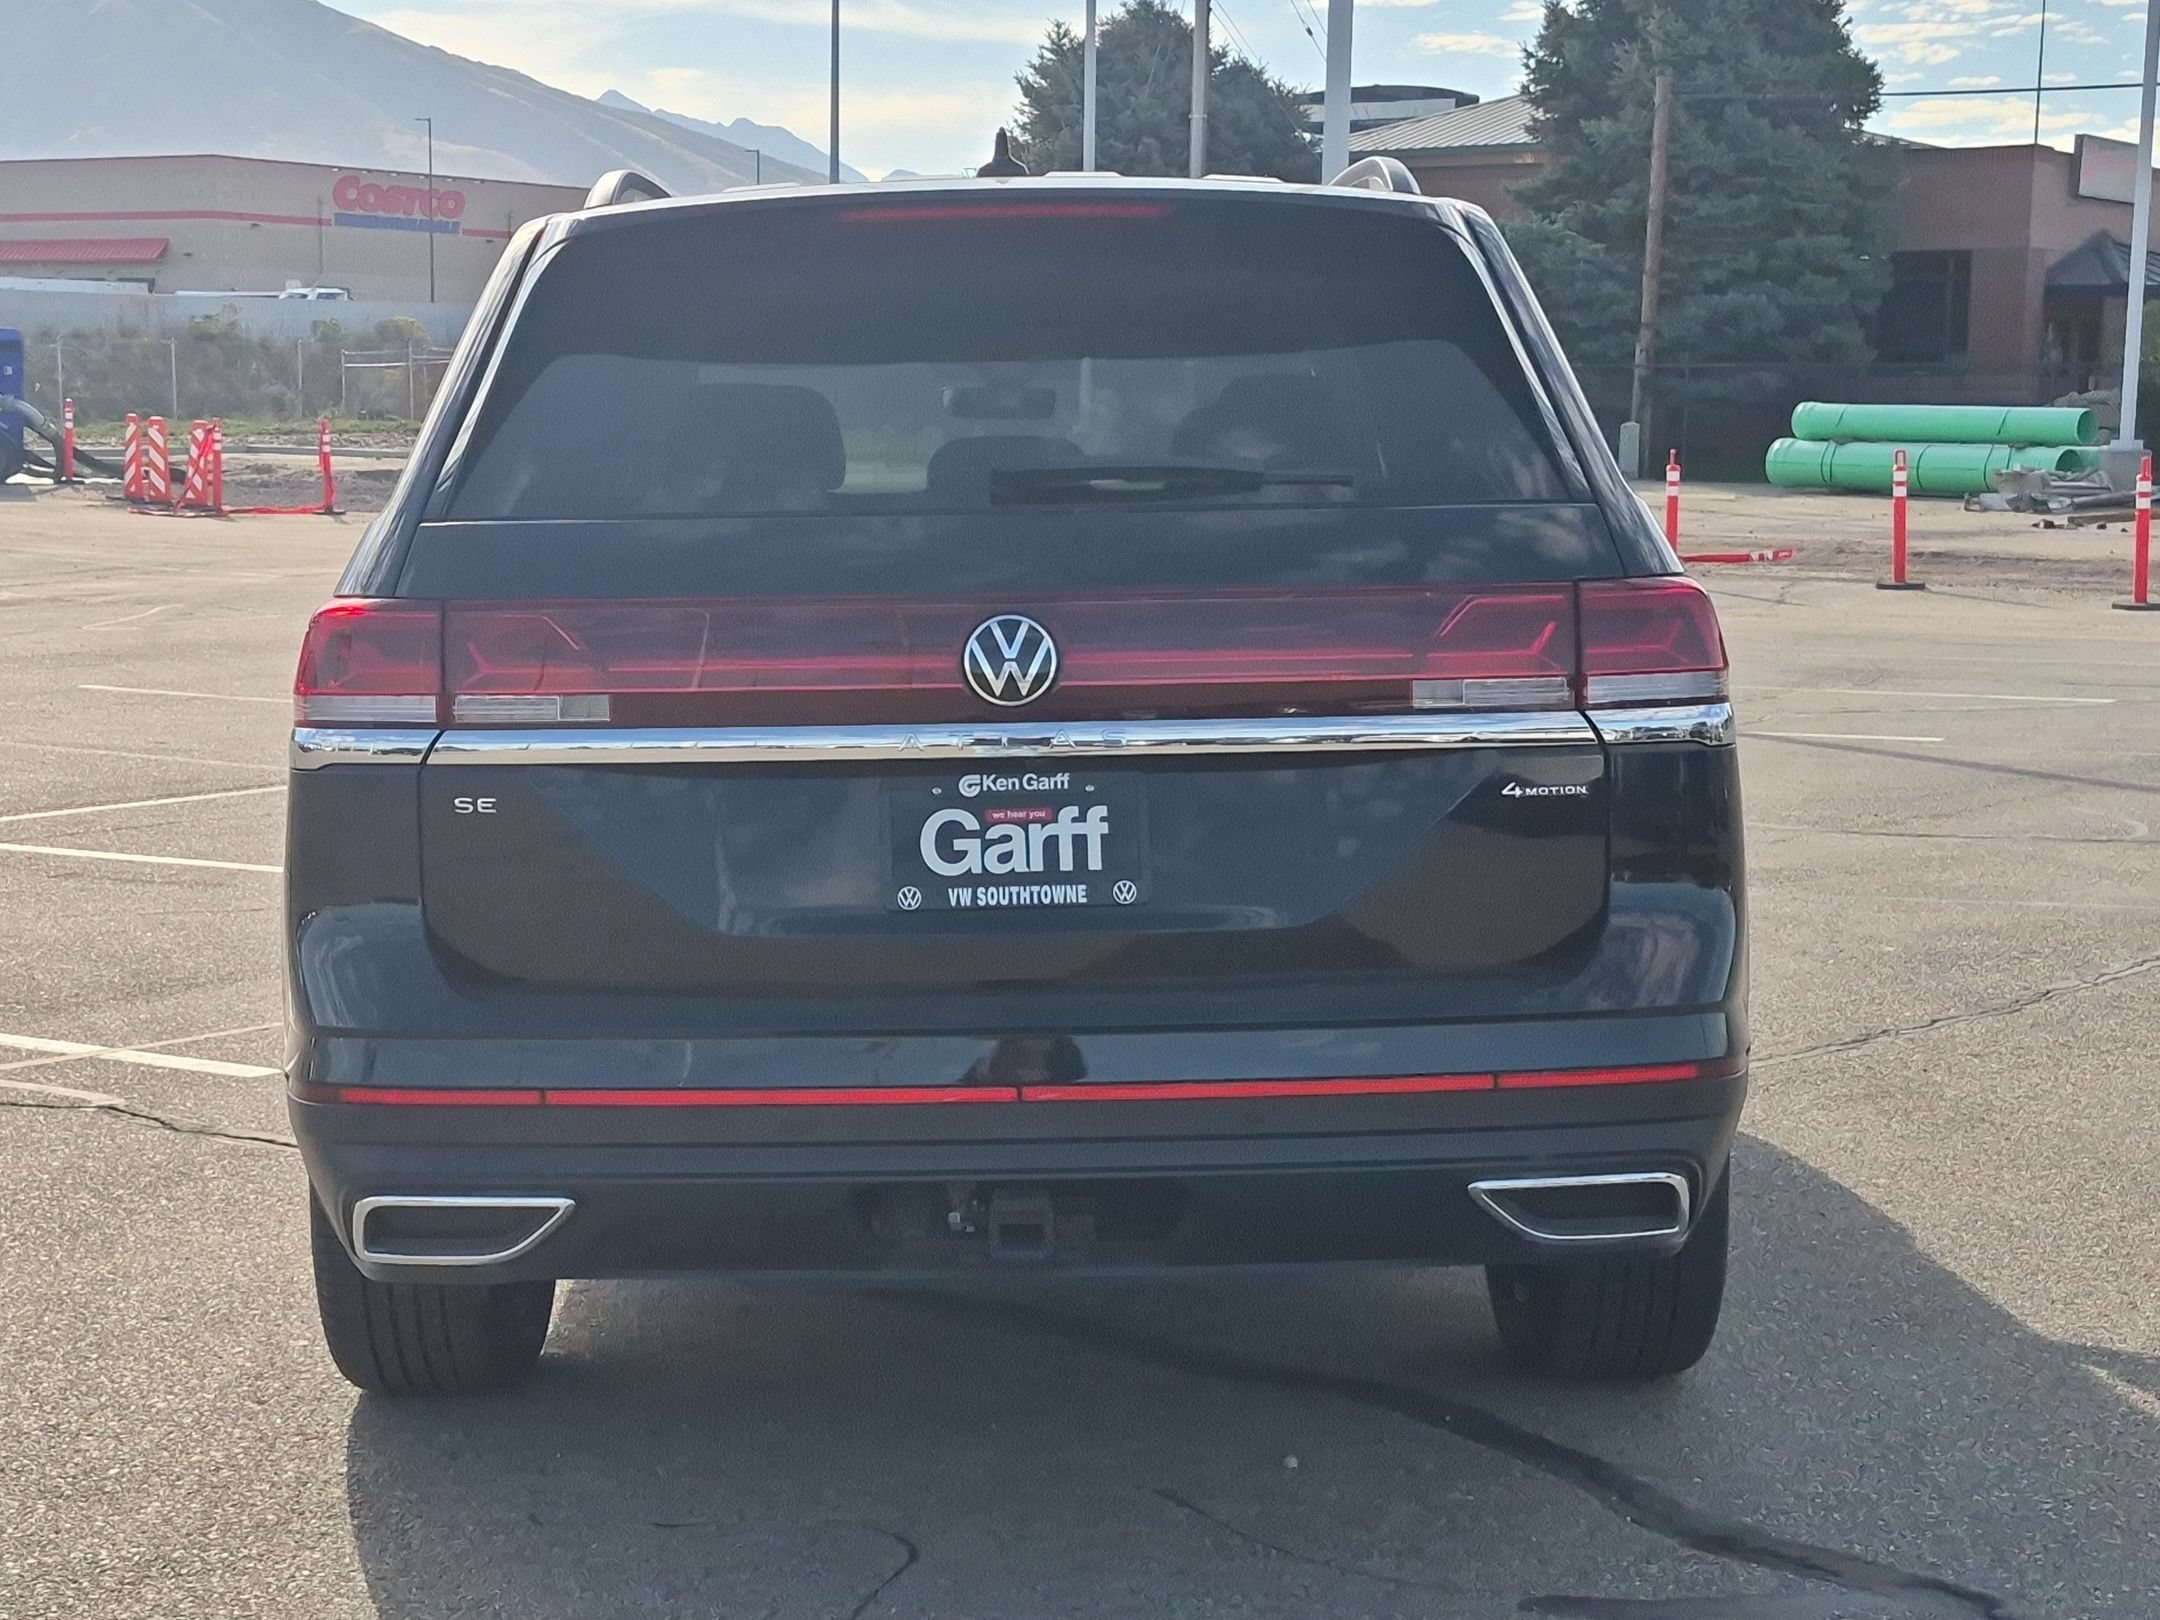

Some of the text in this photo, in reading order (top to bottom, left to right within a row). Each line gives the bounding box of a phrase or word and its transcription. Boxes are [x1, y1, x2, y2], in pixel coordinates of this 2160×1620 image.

[982, 772, 1070, 792] Ken Garff
[453, 797, 497, 813] SE
[1007, 810, 1027, 819] hear
[1028, 810, 1046, 820] you
[919, 805, 1109, 877] Garff
[948, 884, 1087, 907] VW SOUTHTOWNE
